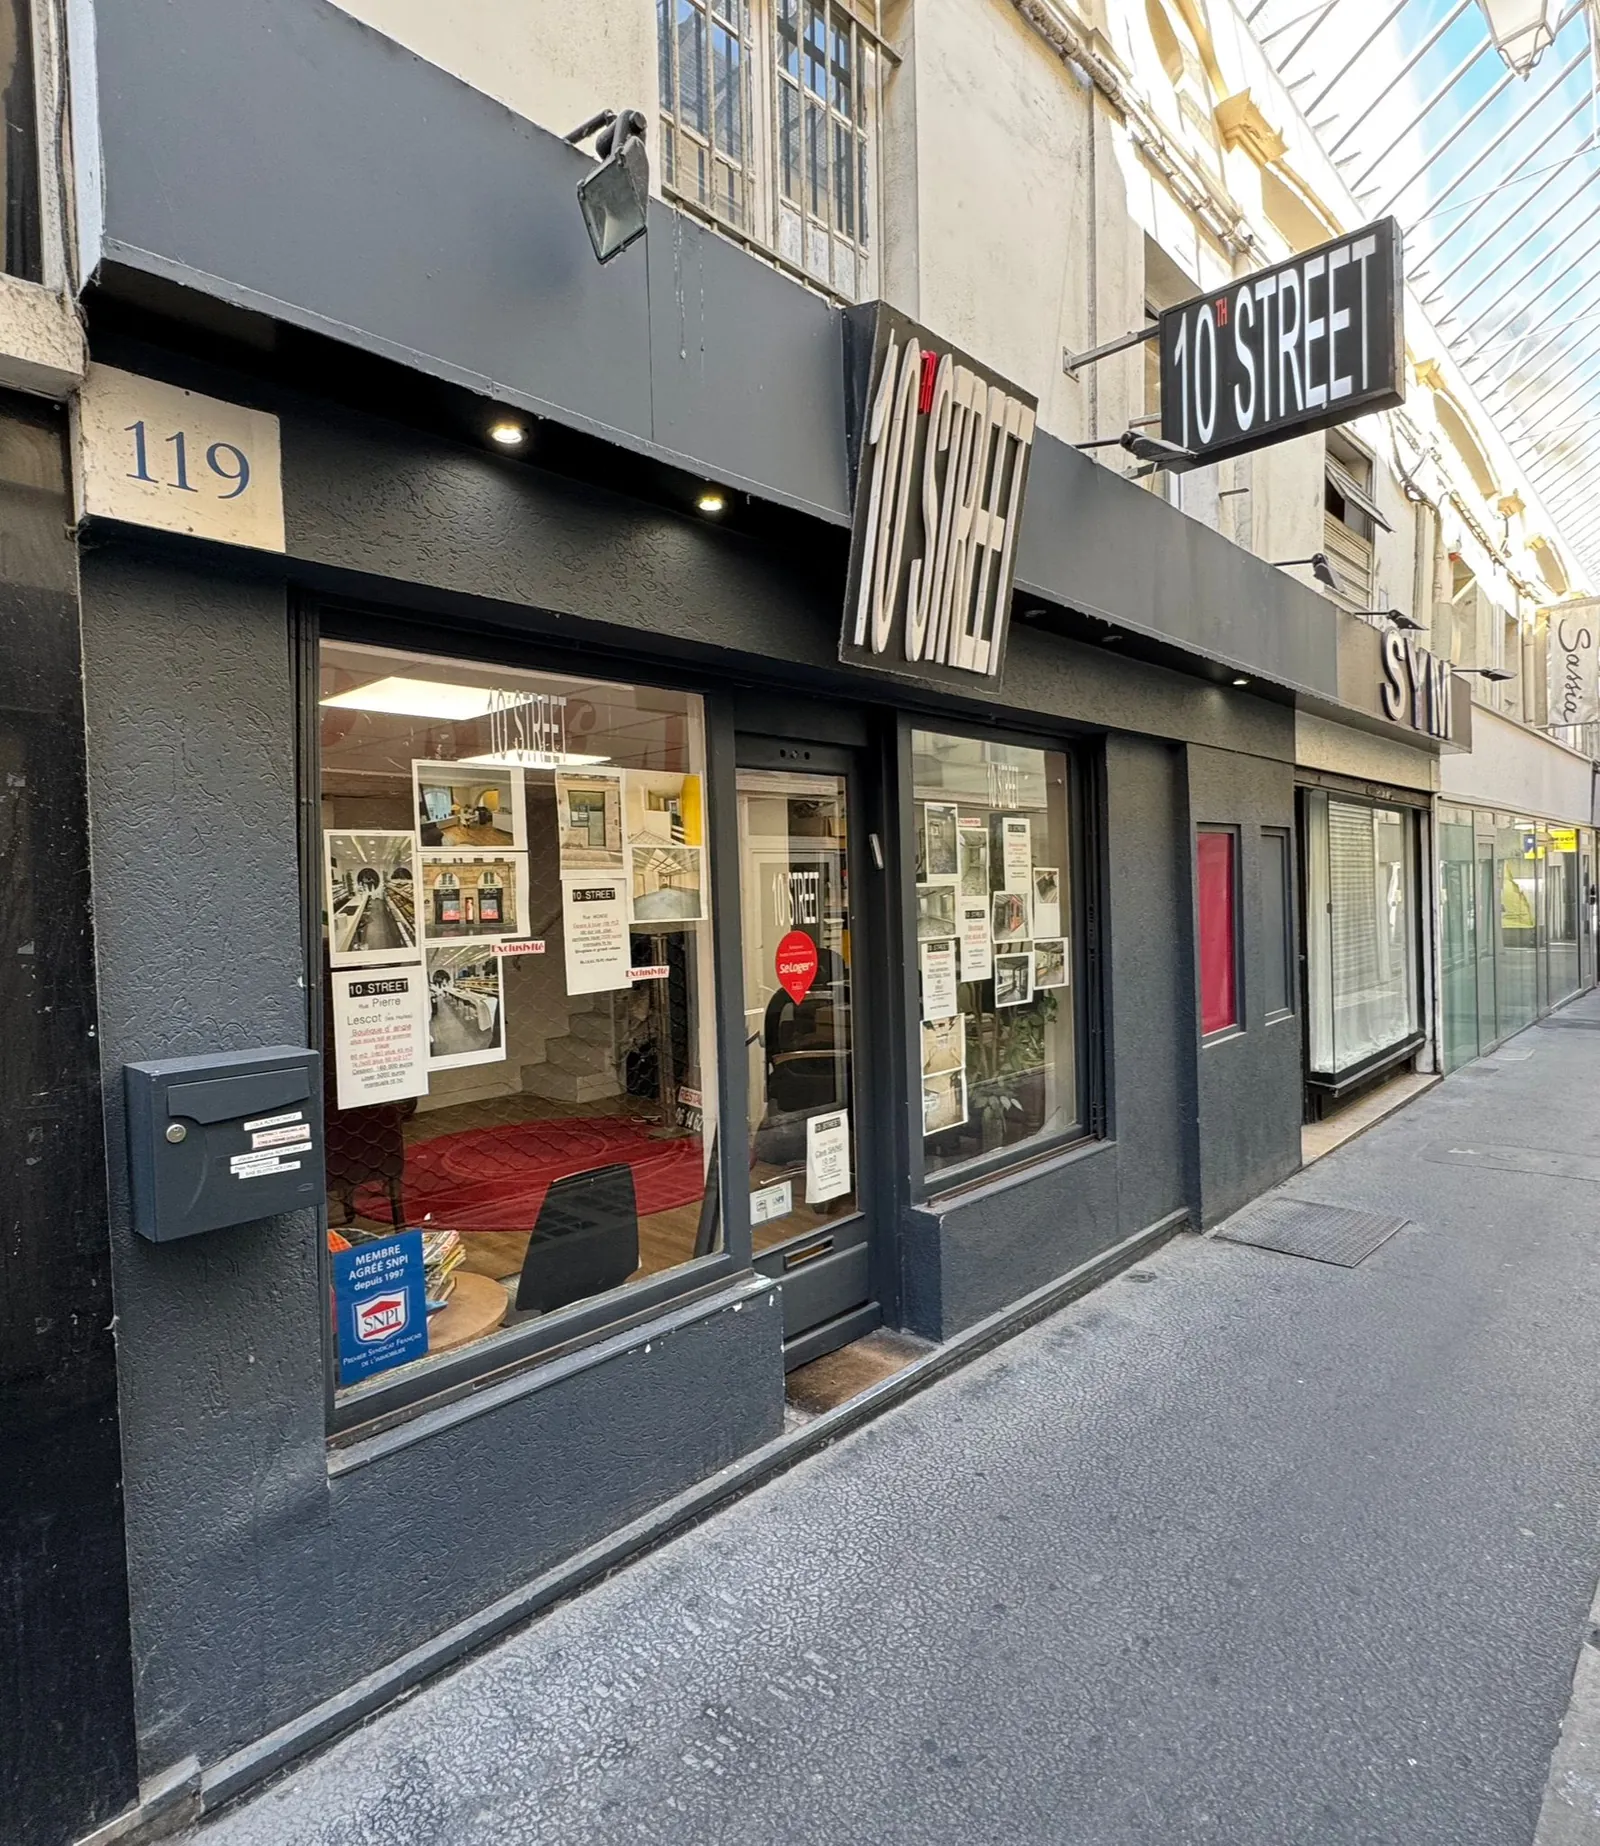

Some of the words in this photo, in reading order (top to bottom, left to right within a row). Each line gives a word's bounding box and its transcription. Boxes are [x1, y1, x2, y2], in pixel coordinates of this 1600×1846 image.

[1174, 304, 1217, 448] 10
[1215, 297, 1228, 327] TH
[1234, 234, 1376, 431] STREET
[124, 420, 251, 499] 119
[854, 328, 921, 654] 10
[905, 354, 1036, 676] STREET
[1379, 626, 1453, 740] SYM
[1558, 619, 1591, 723] Sassia
[513, 689, 567, 762] STREET
[585, 889, 615, 900] STREET
[771, 871, 785, 926] 10
[788, 871, 819, 925] STREET
[350, 985, 363, 995] 10
[367, 980, 408, 994] STREET
[372, 997, 401, 1008] Pierre
[347, 1013, 382, 1026] Lescot
[348, 1260, 384, 1281] AGRÉÉ
[386, 1254, 409, 1269] SNPI
[355, 1244, 401, 1266] MEMBRE
[354, 1276, 383, 1291] depuis
[384, 1268, 404, 1281] 1997
[363, 1308, 400, 1332] SNPI
